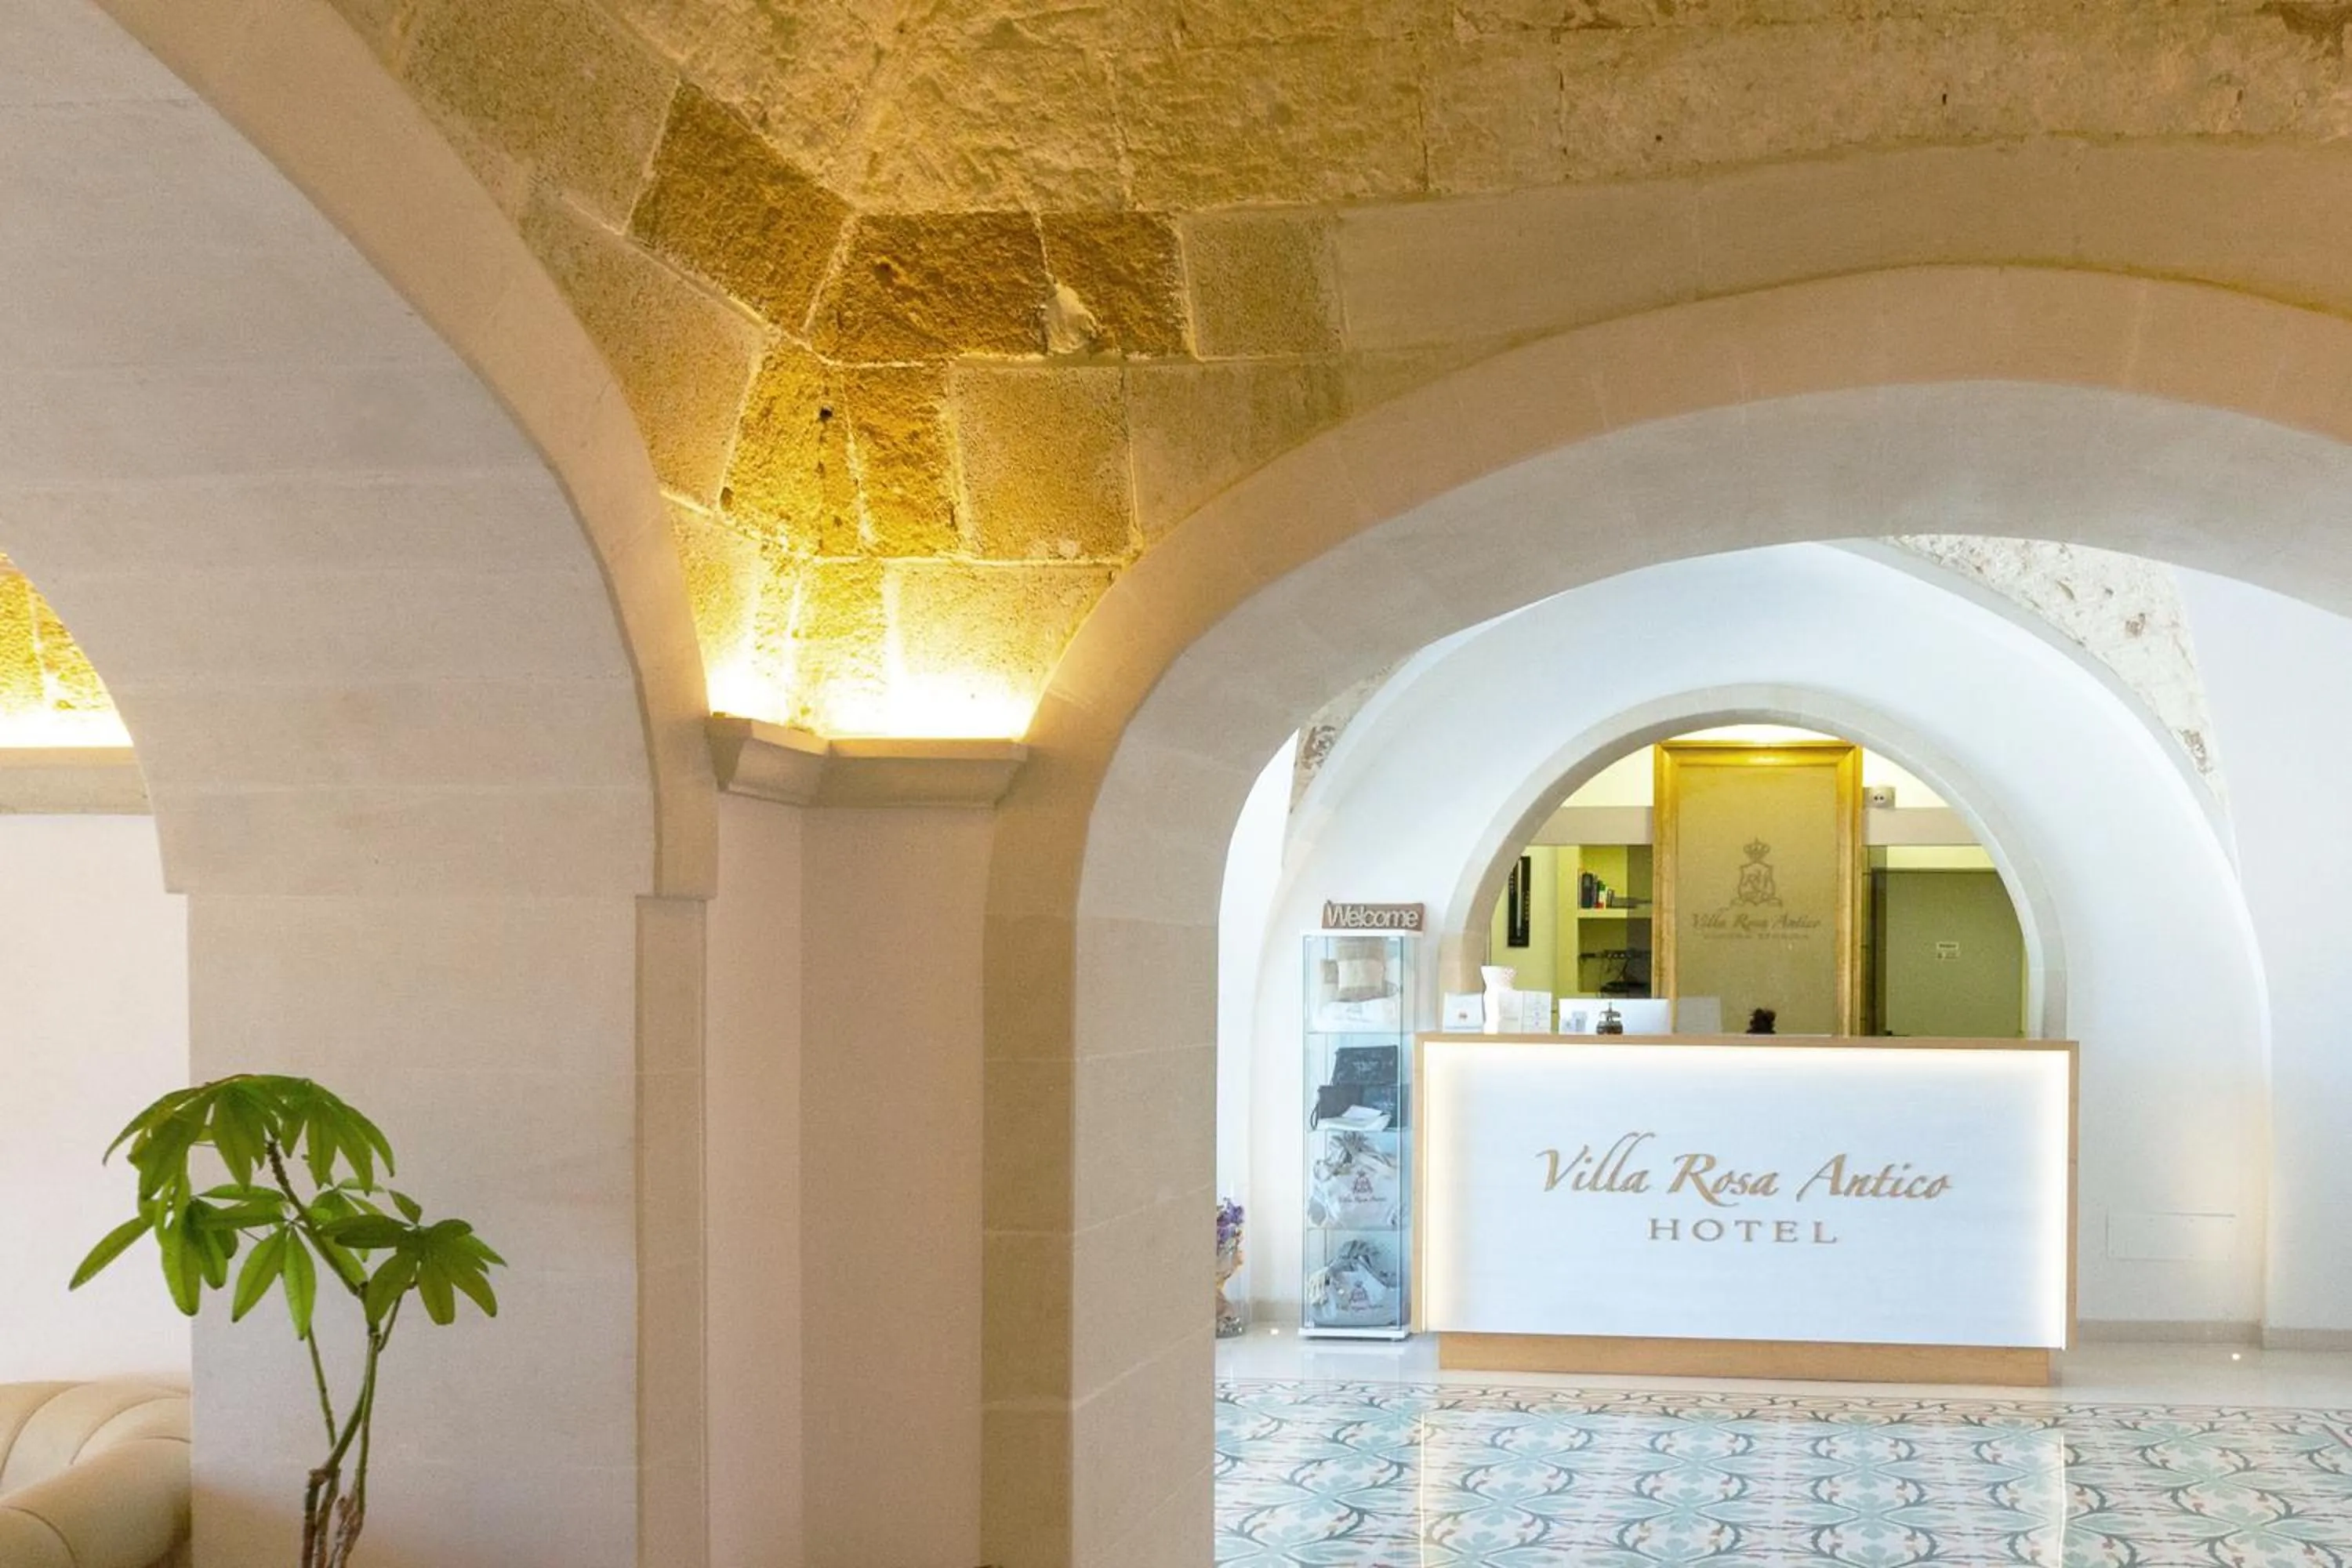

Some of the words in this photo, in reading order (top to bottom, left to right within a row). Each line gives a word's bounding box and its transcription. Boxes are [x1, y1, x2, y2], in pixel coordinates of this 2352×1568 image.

[1327, 899, 1419, 927] Welcome
[1535, 1131, 1656, 1194] Villa
[1667, 1152, 1780, 1208] Rosa
[1795, 1152, 1956, 1203] Antico
[1647, 1218, 1839, 1245] HOTEL
